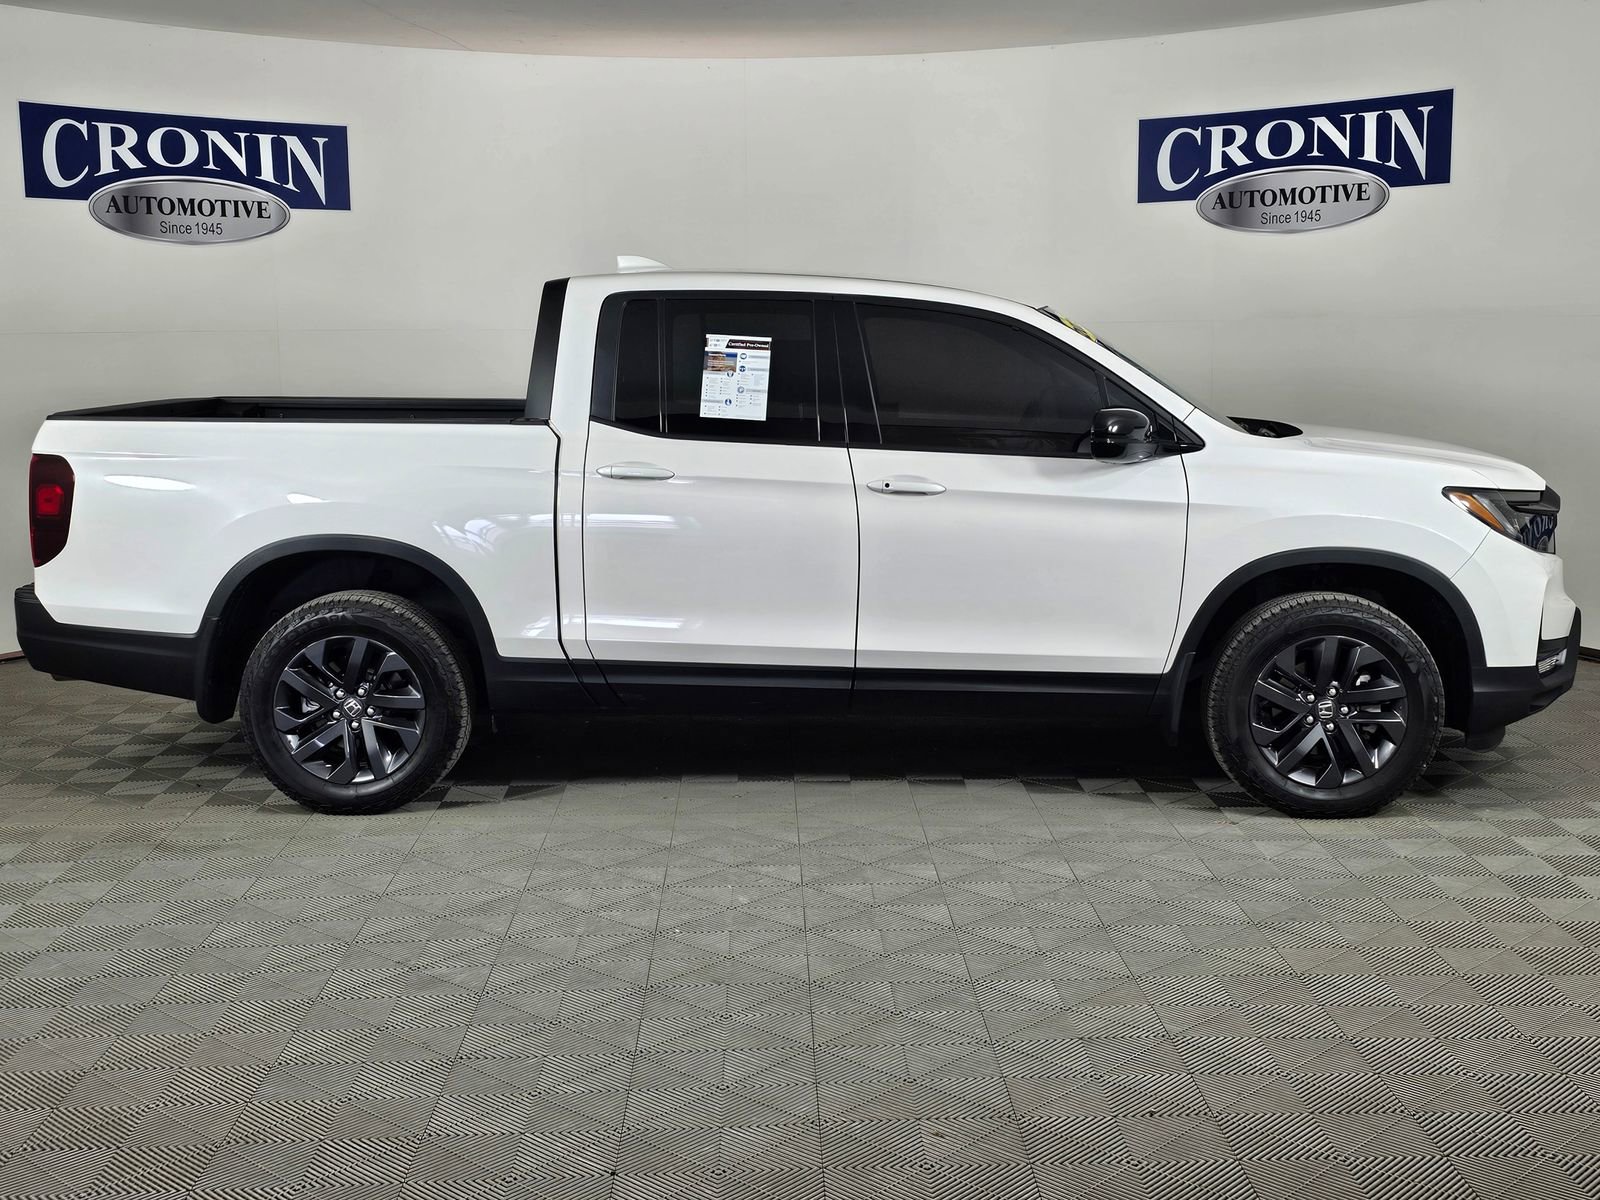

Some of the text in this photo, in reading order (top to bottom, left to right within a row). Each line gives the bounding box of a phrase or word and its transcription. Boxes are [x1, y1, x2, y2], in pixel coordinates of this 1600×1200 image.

[1157, 105, 1434, 191] CRONIN
[42, 118, 328, 206] CRONIN
[105, 194, 271, 219] AUTOMOTIVE
[1212, 182, 1371, 210] AUTOMOTIVE
[159, 220, 223, 236] Since 1945
[1260, 209, 1321, 225] Since 1945
